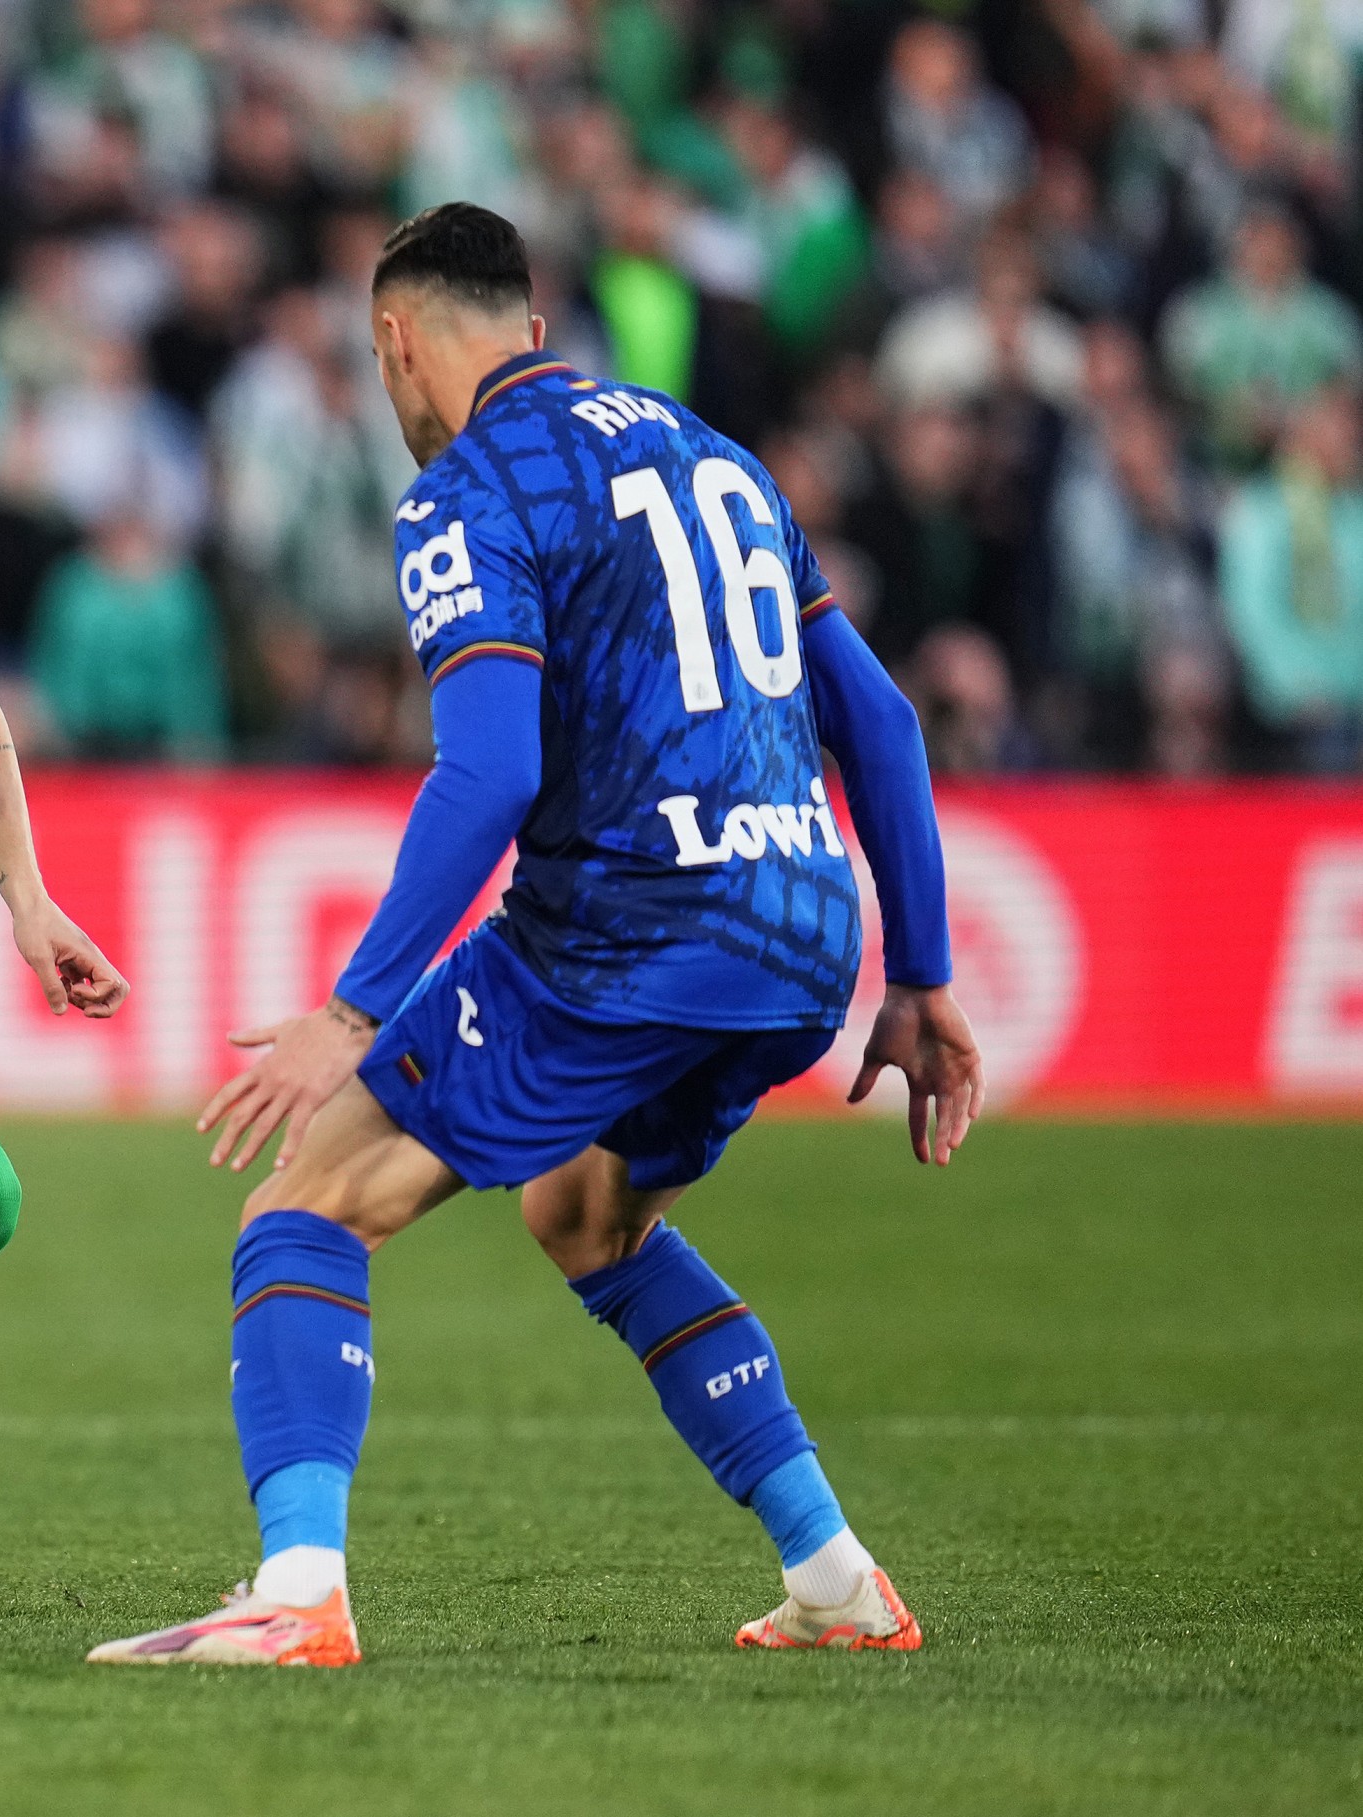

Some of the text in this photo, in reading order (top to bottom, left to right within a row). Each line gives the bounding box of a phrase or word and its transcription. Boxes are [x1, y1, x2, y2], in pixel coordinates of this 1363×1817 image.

[570, 390, 681, 437] RICO
[611, 457, 803, 713] 16
[656, 776, 845, 867] Lowi
[705, 1354, 771, 1400] GTF
